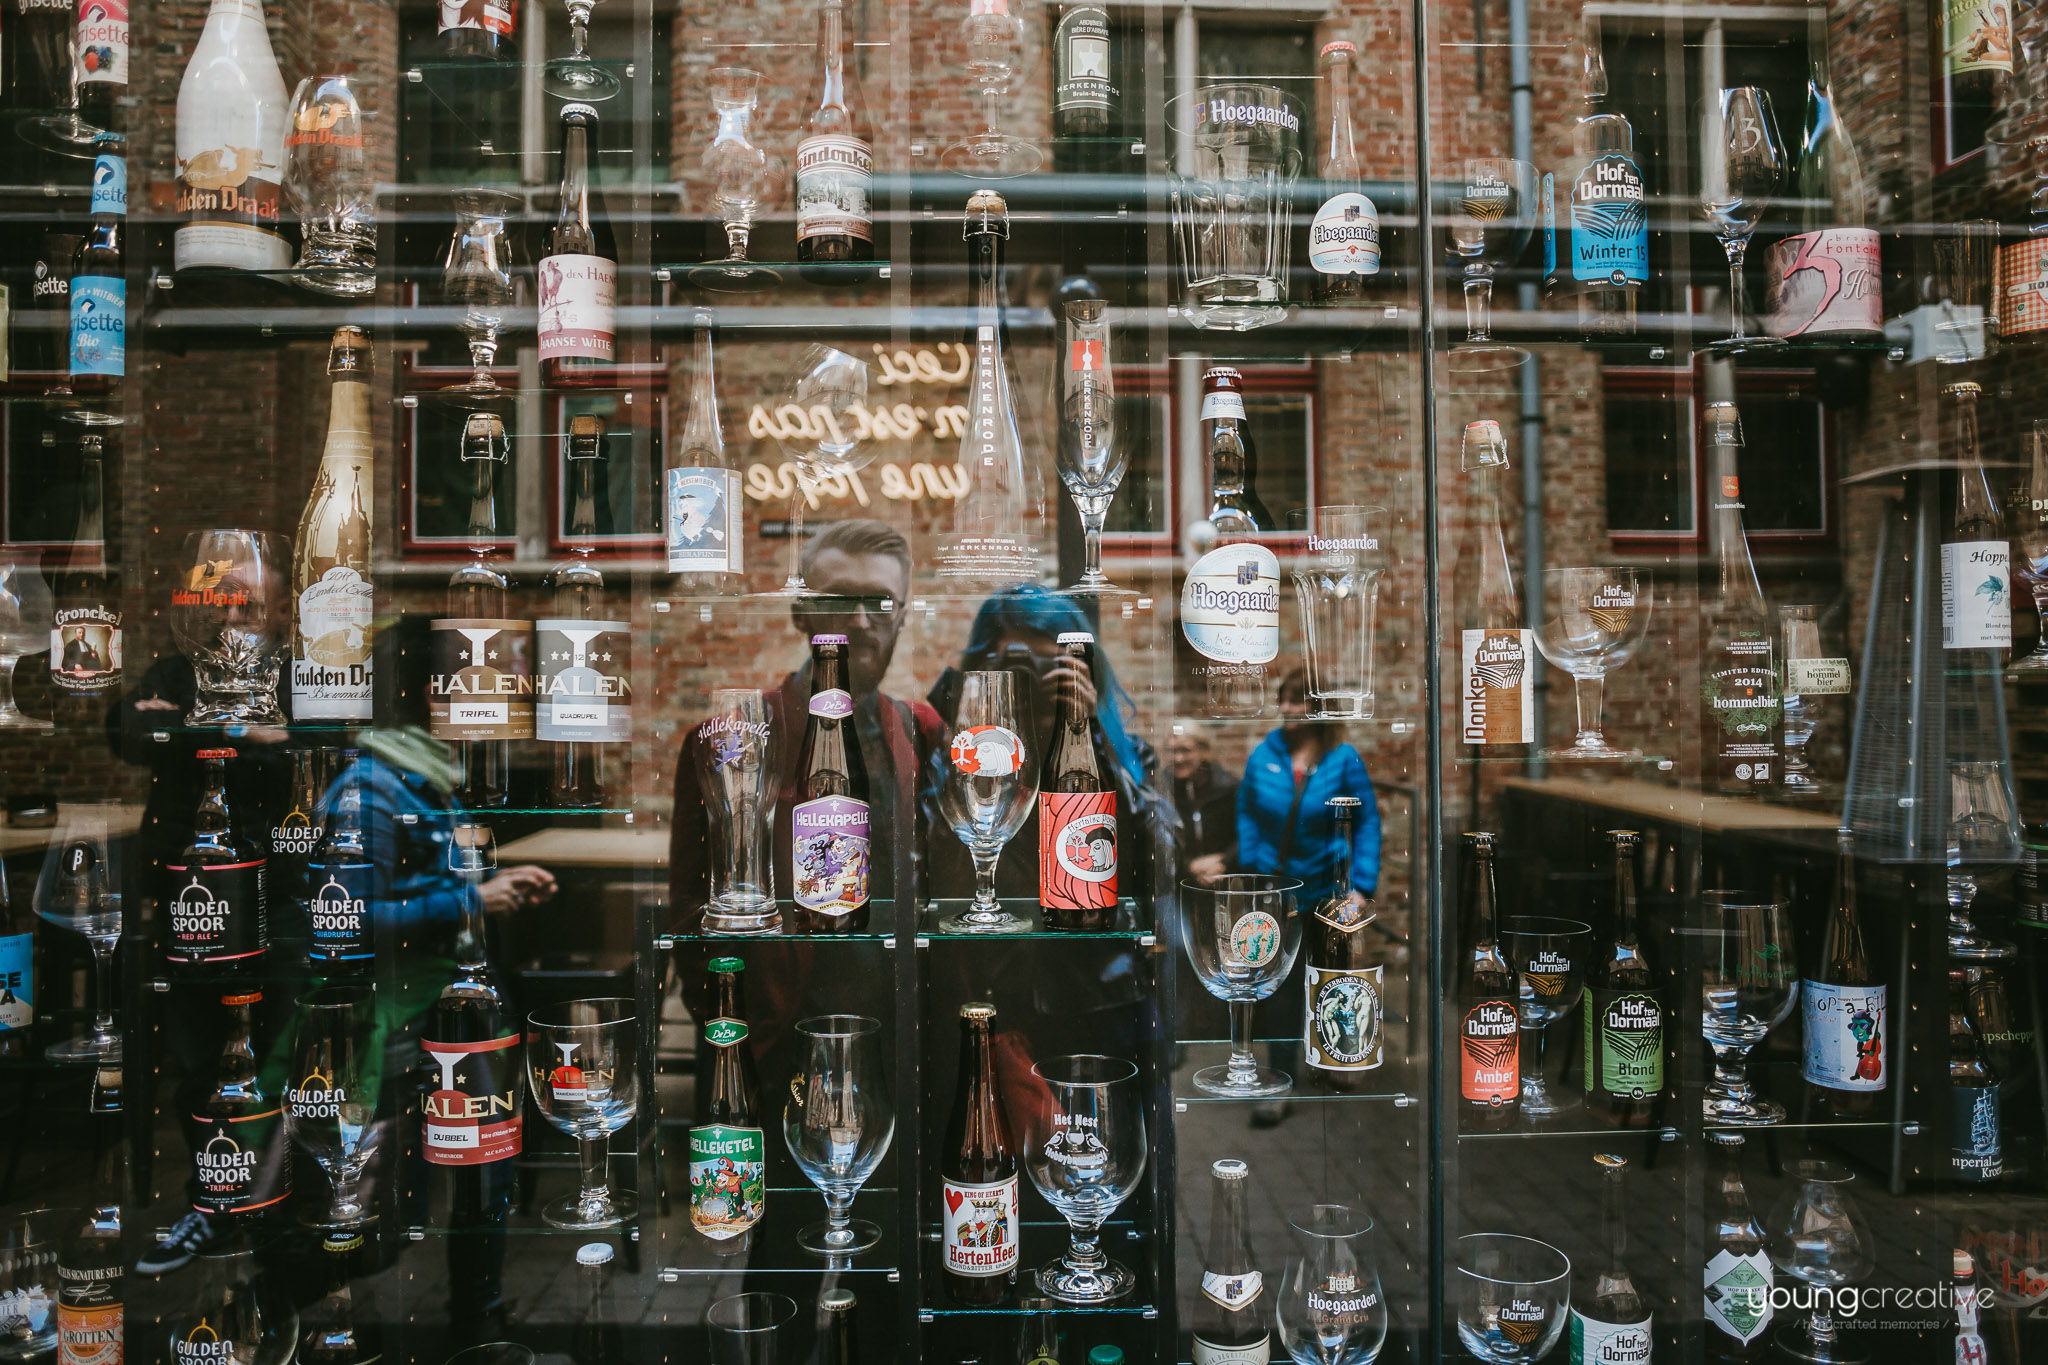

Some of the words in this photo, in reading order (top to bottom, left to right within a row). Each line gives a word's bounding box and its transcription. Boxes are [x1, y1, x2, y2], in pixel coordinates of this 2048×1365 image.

[1211, 99, 1299, 133] Hoegaarden
[1476, 175, 1494, 188] Hof
[1596, 163, 1625, 182] Hof
[1624, 175, 1638, 185] ten
[1466, 185, 1509, 198] Dormaal
[1580, 181, 1644, 201] Dormaal
[220, 186, 280, 221] Draak
[1580, 243, 1633, 260] Winter
[1636, 246, 1646, 261] 15
[92, 287, 124, 308] WITBIER
[76, 333, 100, 347] Bio
[981, 345, 996, 467] HERKENRODE
[1083, 373, 1093, 449] HERKENRODE
[1307, 535, 1379, 553] Hoegaarden
[203, 588, 249, 606] Draak
[1603, 584, 1621, 598] Hof
[1621, 590, 1631, 598] ten
[1593, 594, 1635, 608] Dormaal
[1489, 637, 1508, 650] Hof
[1480, 647, 1523, 663] Dormaal
[1711, 667, 1749, 679] LIMITED
[1734, 678, 1763, 688] 2014
[1817, 678, 1834, 687] bier
[1465, 667, 1487, 744] Donker
[1713, 695, 1779, 709] hommelbier
[459, 710, 499, 718] TRIPEL
[698, 715, 771, 744] Hellekapelle
[271, 826, 323, 840] GULDEN
[170, 900, 231, 916] GULDEN
[310, 899, 366, 914] GULDEN
[172, 917, 226, 932] SPOOR
[313, 915, 361, 930] SPOOR
[316, 930, 355, 938] QUADRUPEL
[1539, 951, 1557, 963] Hof
[1529, 959, 1570, 973] Dormaal
[1325, 976, 1359, 990] VERBODEN
[1480, 1007, 1503, 1023] Hof
[1502, 1013, 1513, 1022] ten
[1621, 1000, 1644, 1015] Hof
[1644, 1008, 1655, 1016] ten
[1469, 1019, 1517, 1036] Dormaal
[1609, 1012, 1660, 1028] Dormaal
[1322, 1043, 1331, 1053] LE
[1329, 1050, 1349, 1063] FRUIT
[534, 1066, 615, 1086] HALEN
[1474, 1069, 1514, 1083] Amber
[1618, 1062, 1655, 1076] Blond
[289, 1088, 347, 1104] GULDEN
[292, 1103, 341, 1119] SPOOR
[1054, 1114, 1072, 1126] Het
[1074, 1114, 1098, 1127] Nest
[433, 1133, 469, 1142] DUBBEL
[196, 1151, 257, 1168] GULDEN
[199, 1168, 251, 1183] SPOOR
[209, 1184, 235, 1193] TRIPEL
[964, 1191, 977, 1199] KING
[71, 1268, 105, 1280] SIGNATURE
[1307, 1291, 1377, 1316] Hoegaarden
[1512, 1299, 1530, 1312] Hof
[1530, 1304, 1541, 1312] ten
[1321, 1313, 1351, 1326] Grand
[1353, 1313, 1369, 1324] Cru
[1501, 1307, 1545, 1321] Dormaal
[63, 1329, 115, 1344] GROTTEN
[1617, 1334, 1638, 1348] Hof
[177, 1340, 234, 1356] GULDEN
